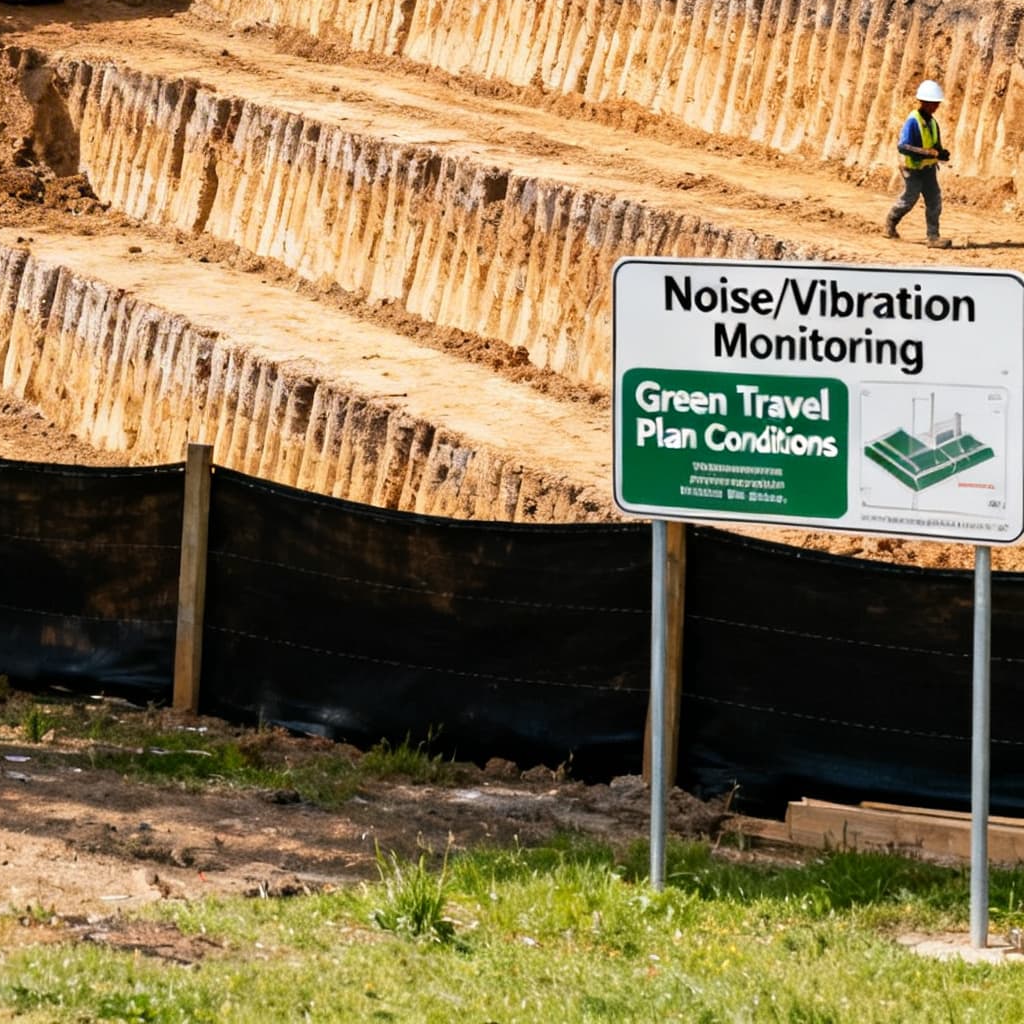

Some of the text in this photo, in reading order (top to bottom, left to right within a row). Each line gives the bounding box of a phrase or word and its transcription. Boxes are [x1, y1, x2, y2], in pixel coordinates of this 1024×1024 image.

[664, 275, 976, 322] Noise/Vibration
[714, 322, 924, 374] Monitoring
[635, 381, 830, 421] Green Travel
[636, 417, 839, 457] Plan Conditions
